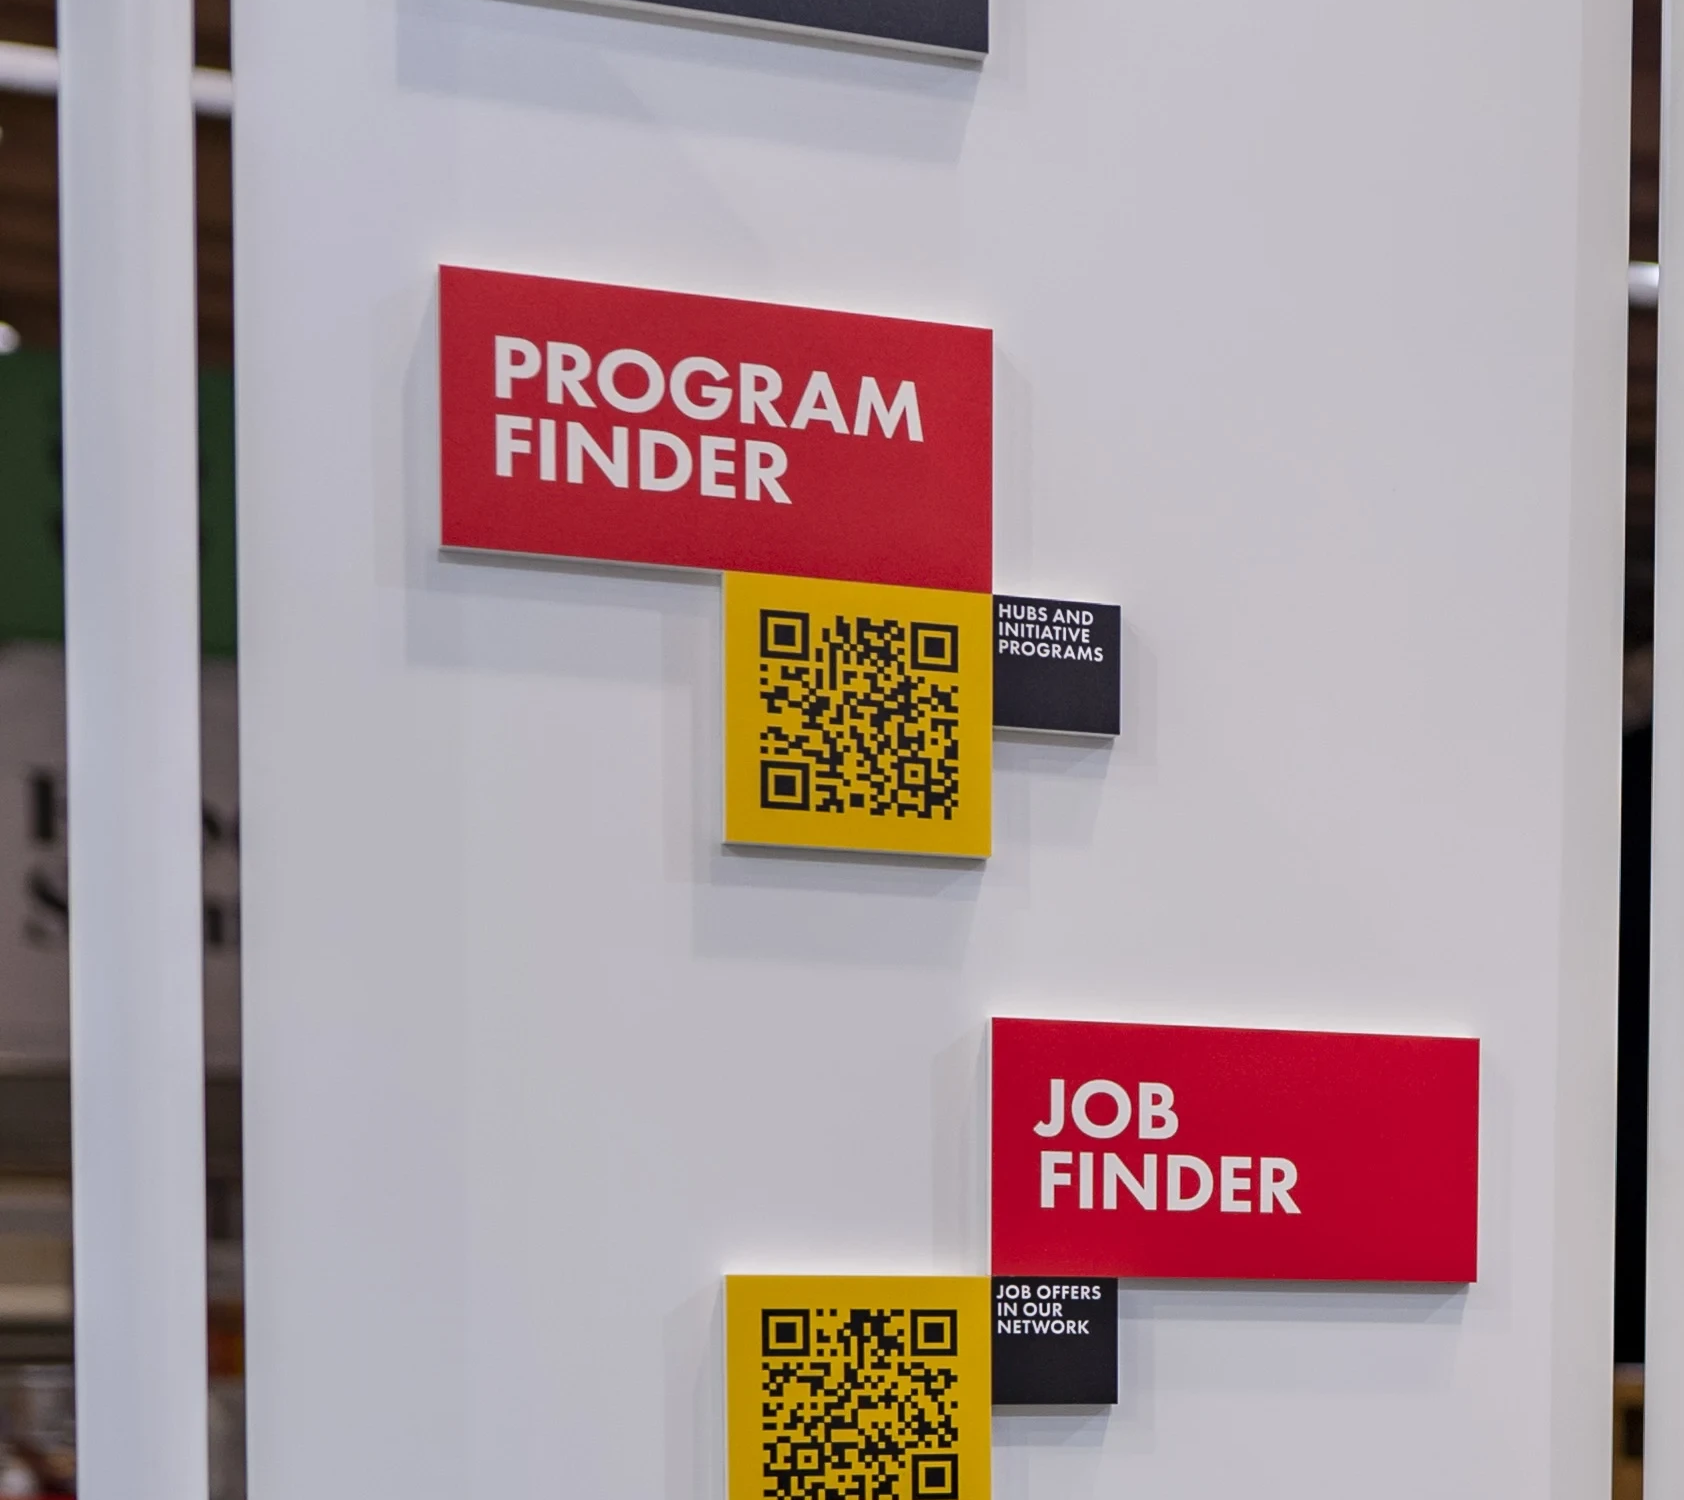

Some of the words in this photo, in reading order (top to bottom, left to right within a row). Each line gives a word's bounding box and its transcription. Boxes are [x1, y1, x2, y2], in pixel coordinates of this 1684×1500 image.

[494, 335, 924, 443] PROGRAM
[495, 414, 792, 505] FINDER
[998, 602, 1048, 622] HUBS
[1051, 608, 1094, 626] AND
[998, 621, 1091, 644] INITIATIVE
[998, 638, 1104, 663] PROGRAMS
[1033, 1078, 1179, 1140] JOB
[1040, 1150, 1302, 1214] FINDER
[995, 1284, 1032, 1300] JOB
[1036, 1284, 1102, 1300] OFFERS
[997, 1301, 1018, 1317] IN
[1022, 1301, 1063, 1318] OUR
[997, 1319, 1090, 1335] NETWORK
